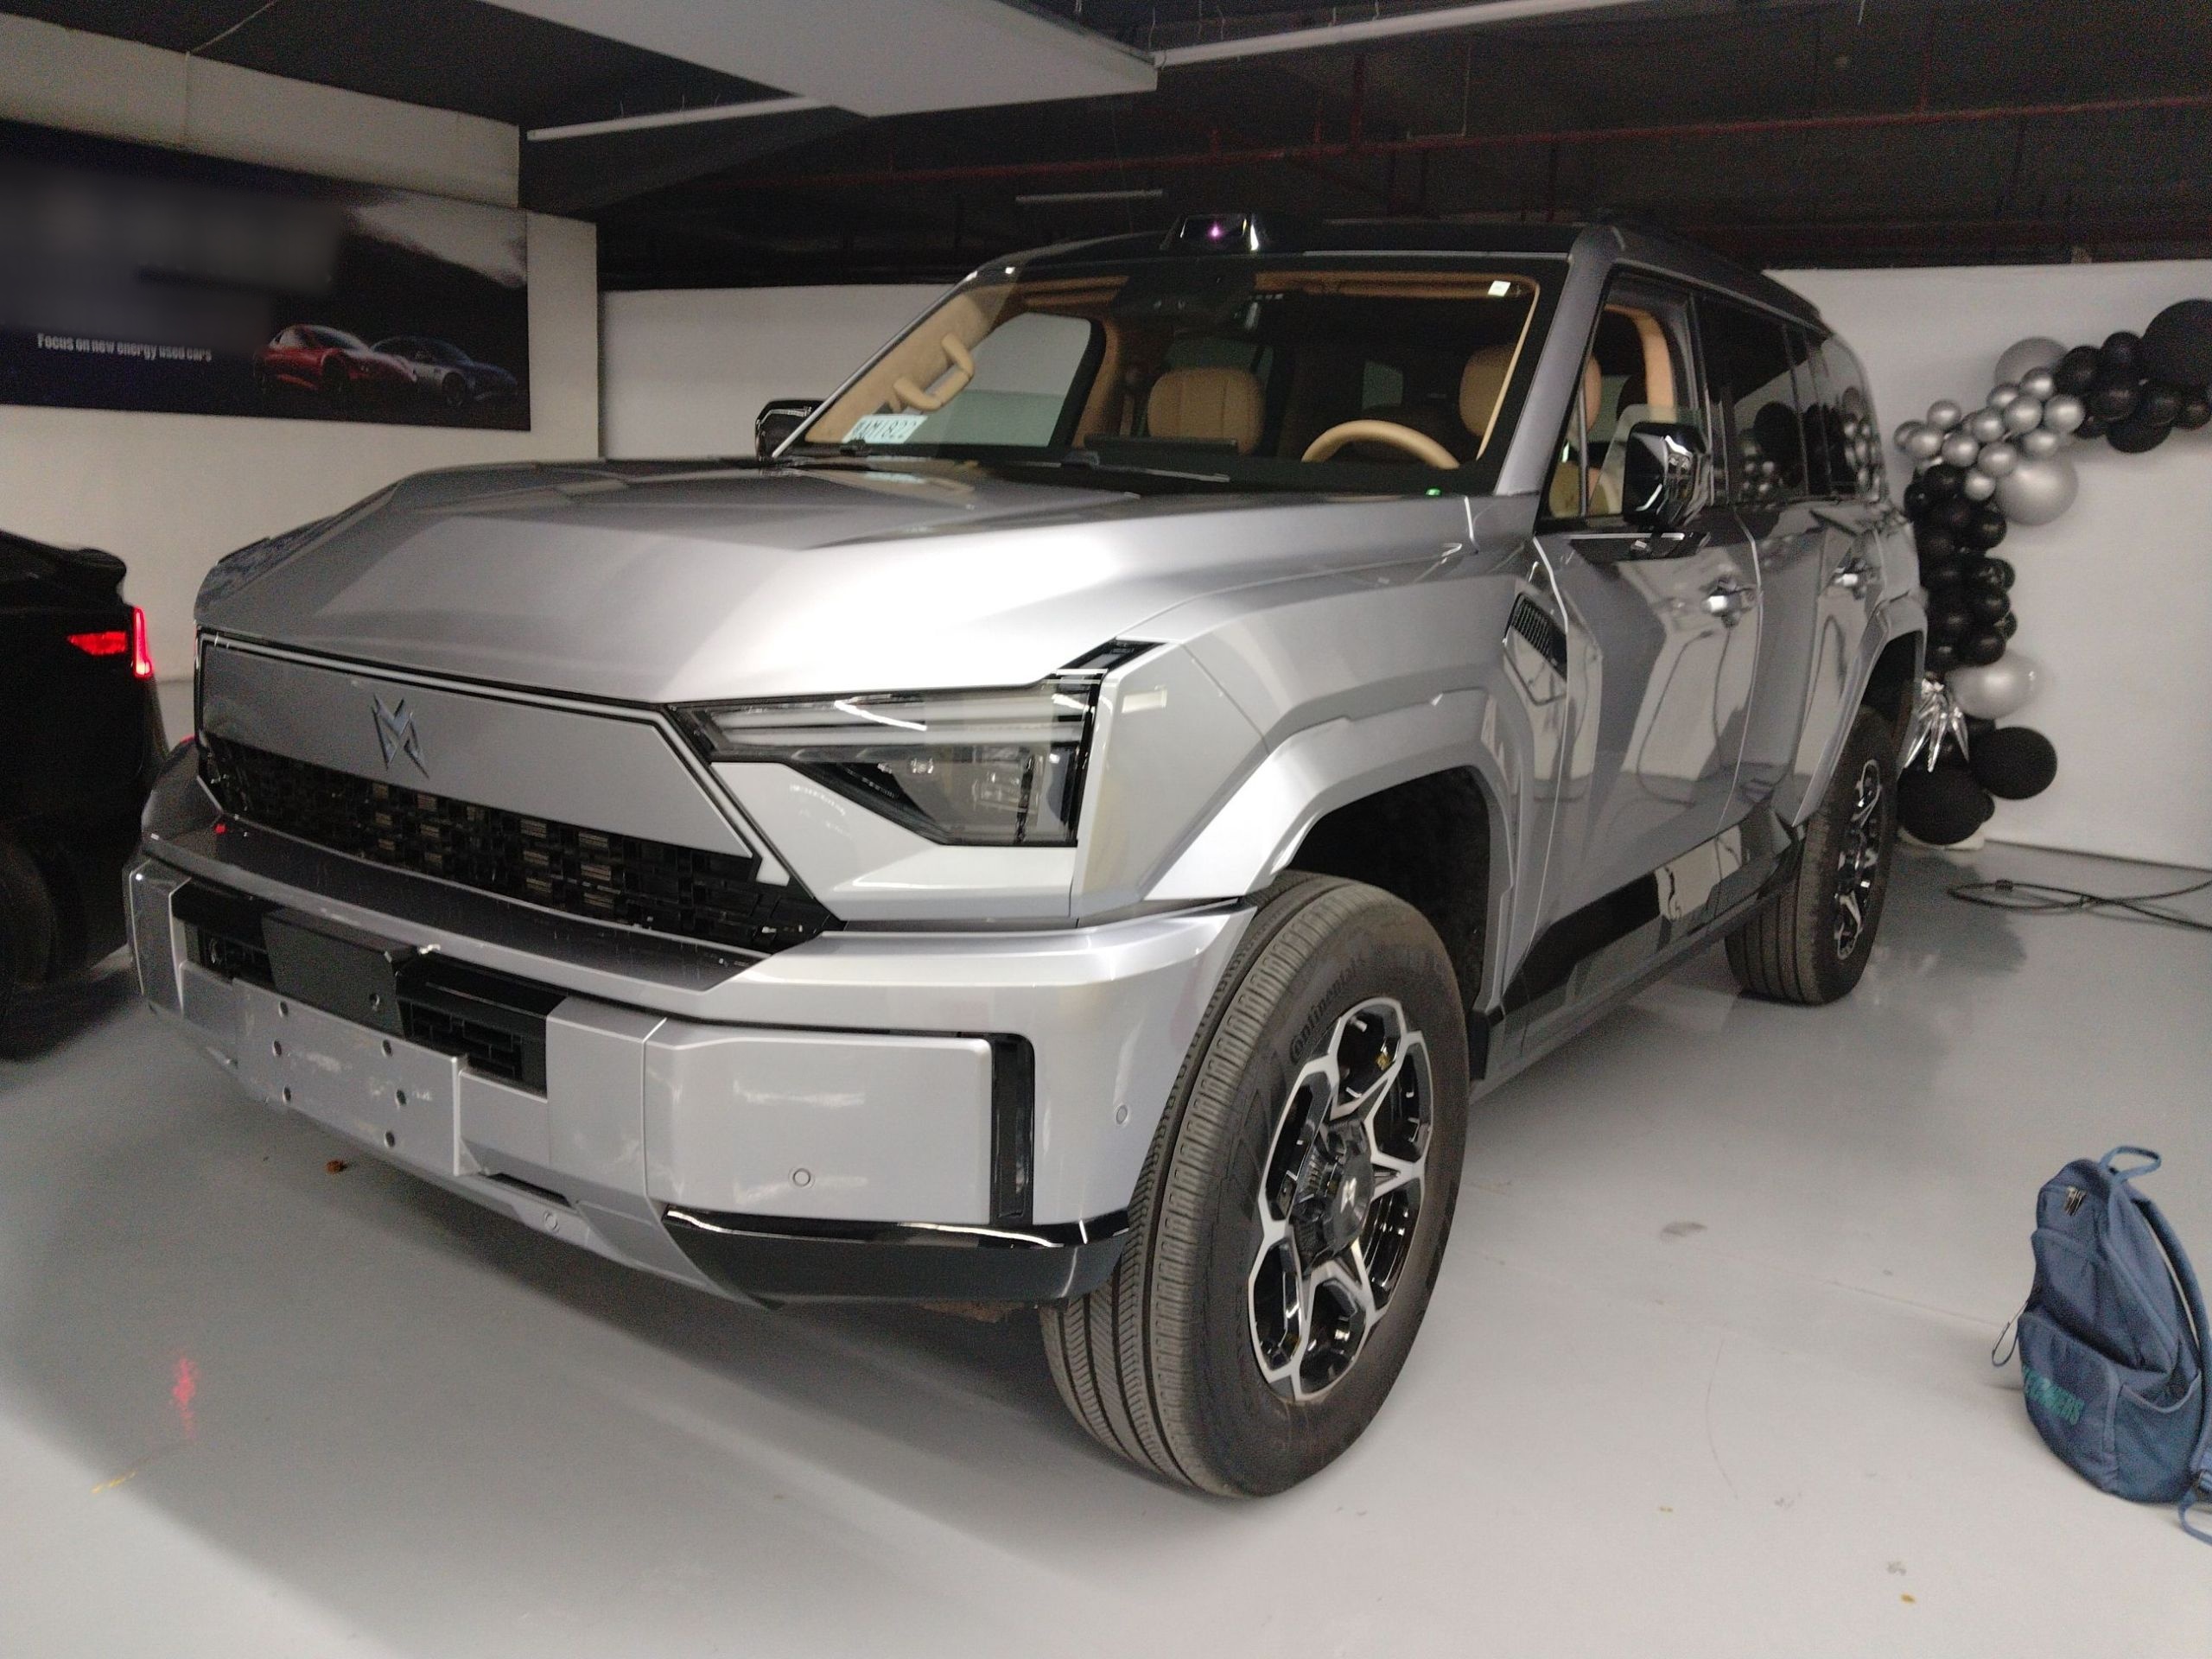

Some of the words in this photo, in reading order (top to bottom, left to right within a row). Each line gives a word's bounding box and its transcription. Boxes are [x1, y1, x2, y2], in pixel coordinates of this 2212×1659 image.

[37, 333, 73, 351] Focus
[75, 338, 90, 353] on
[92, 339, 115, 353] new
[117, 341, 156, 360] energy
[159, 345, 185, 359] used
[186, 346, 213, 362] cars
